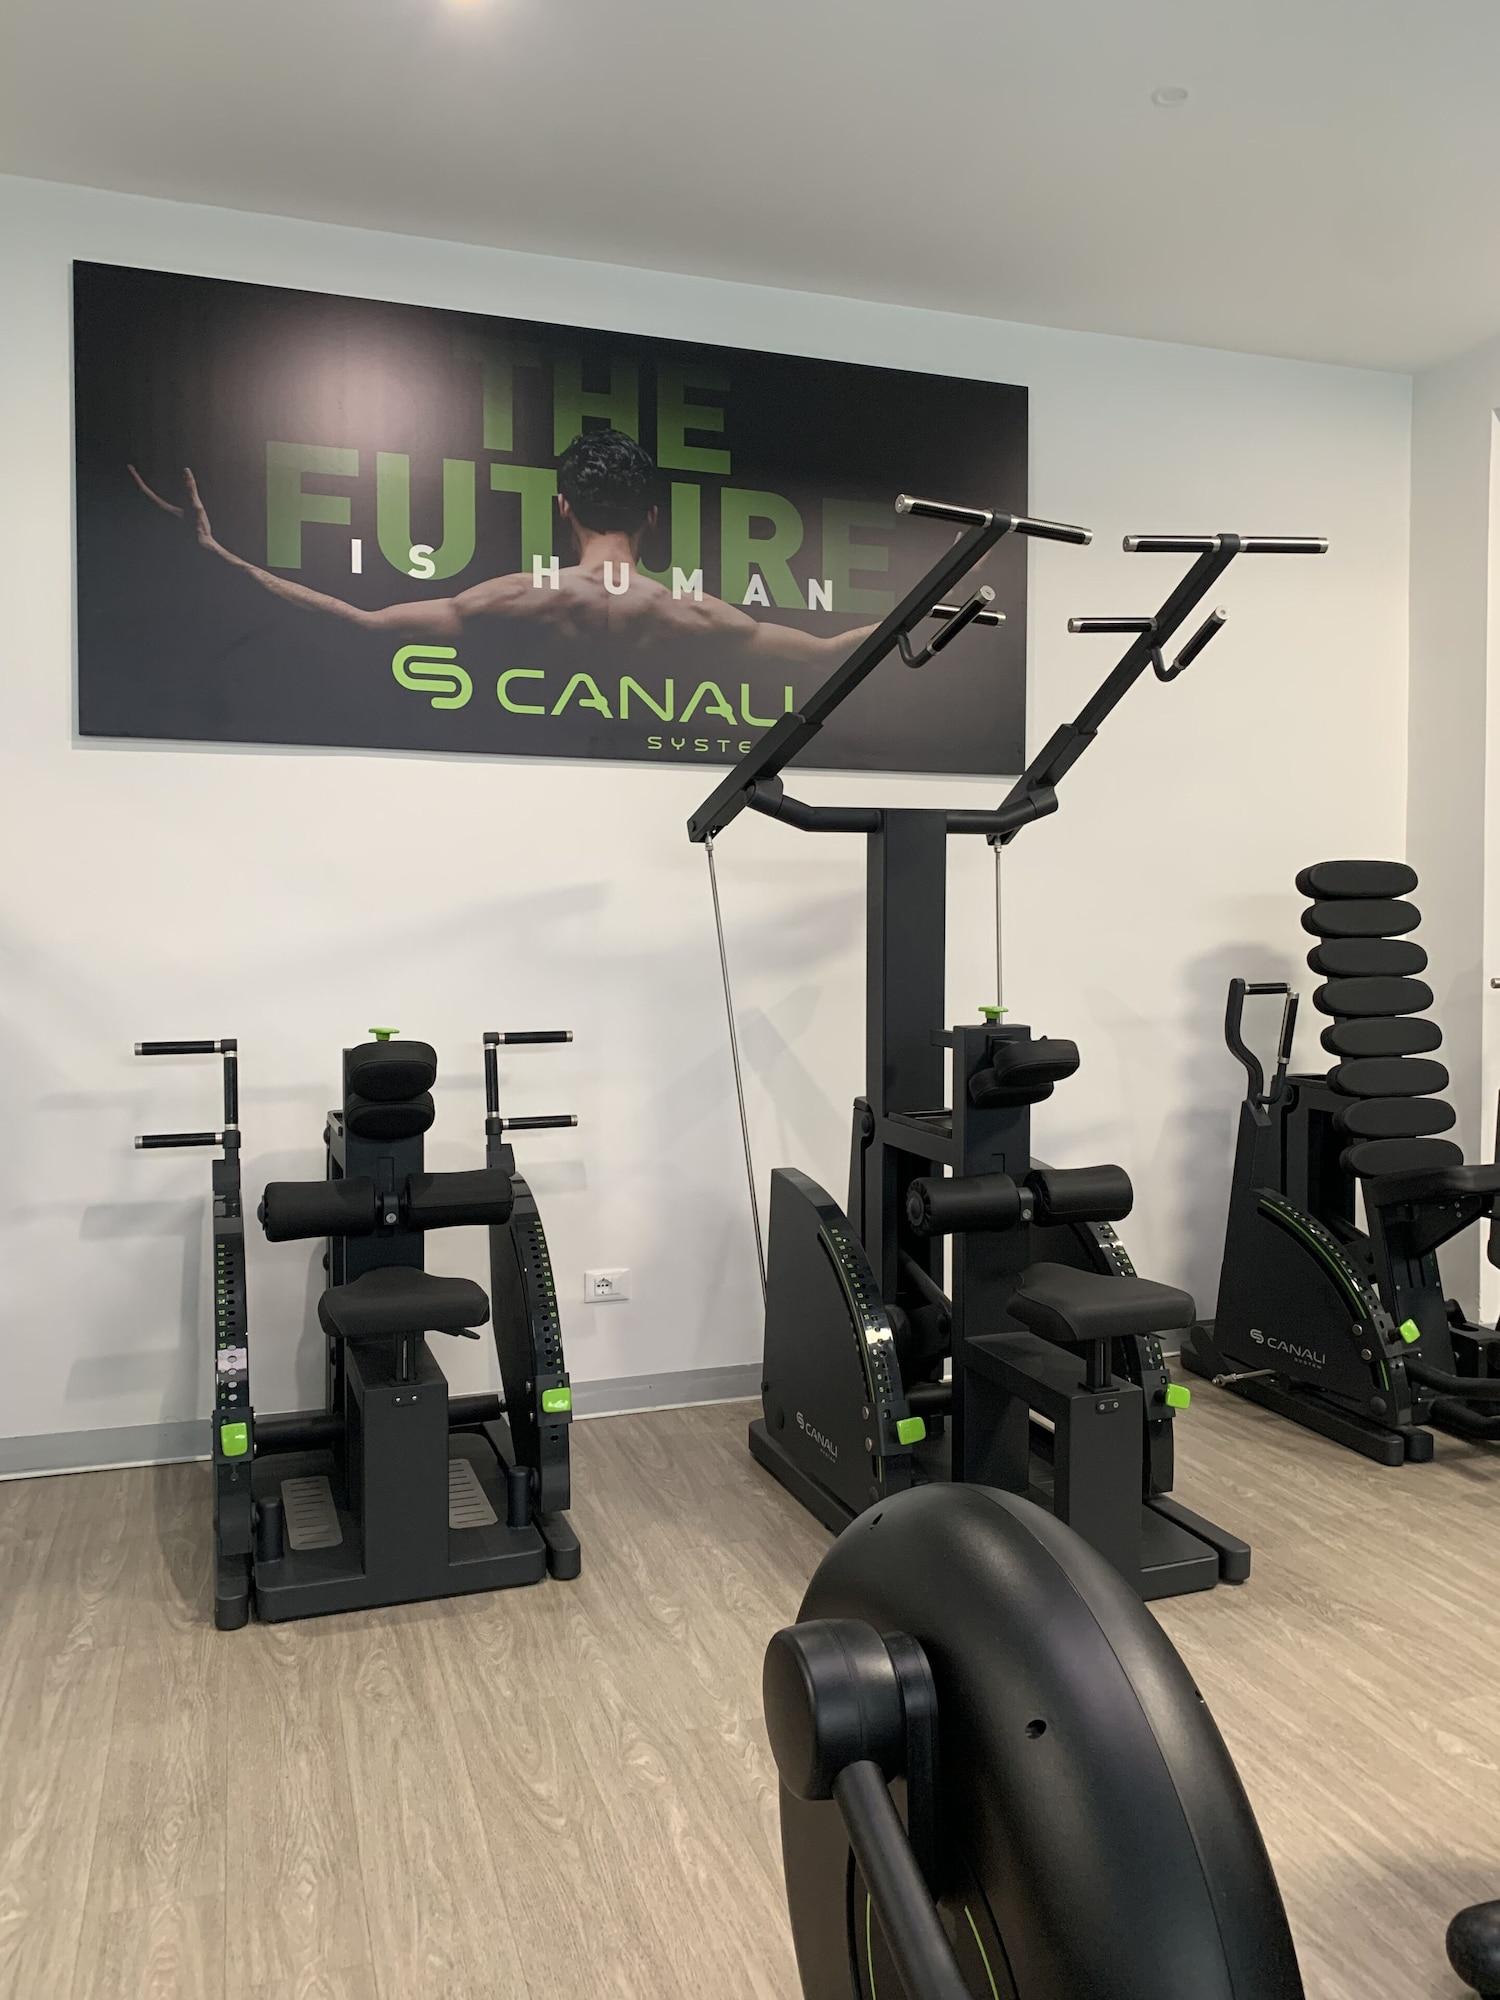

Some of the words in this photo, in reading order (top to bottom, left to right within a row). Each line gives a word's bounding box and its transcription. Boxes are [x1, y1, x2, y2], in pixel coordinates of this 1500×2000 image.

[458, 335, 731, 475] THE
[351, 538, 436, 580] IS
[532, 553, 834, 612] HUMAN
[647, 736, 751, 754] SYSTE
[1267, 1337, 1325, 1364] CANALI
[805, 1422, 838, 1458] CANALI
